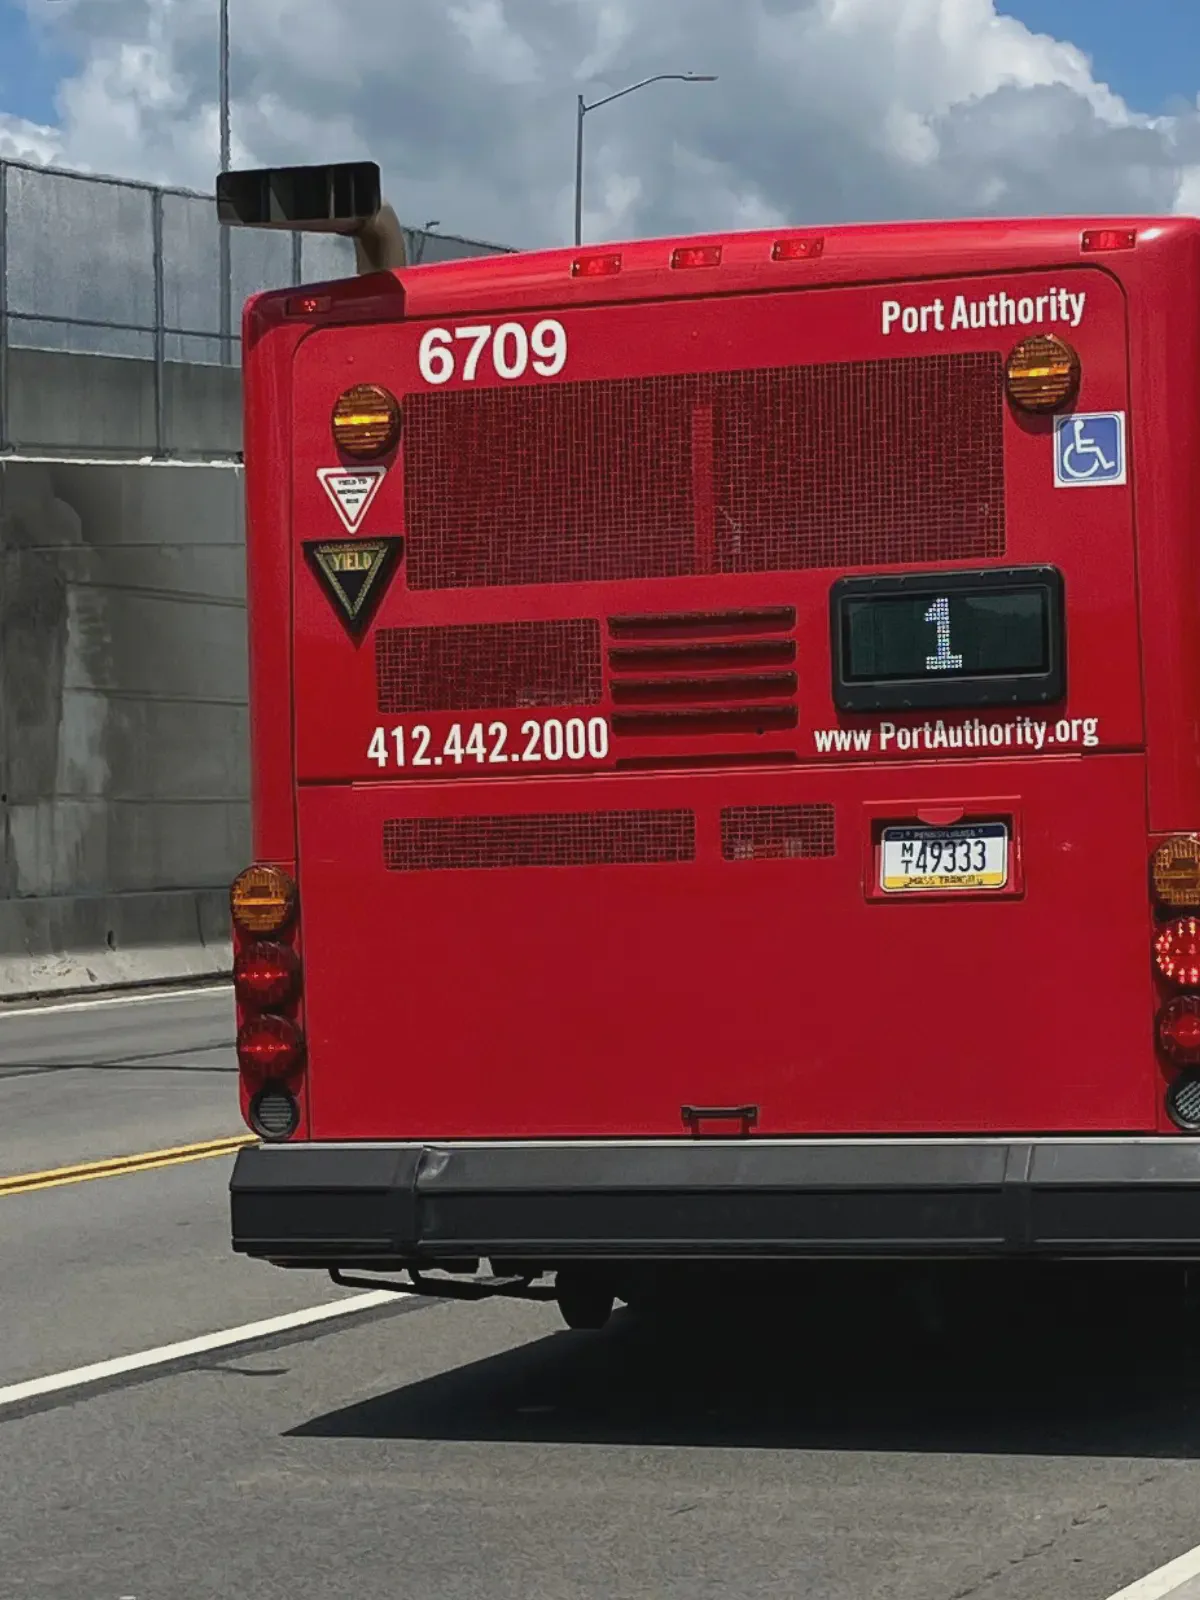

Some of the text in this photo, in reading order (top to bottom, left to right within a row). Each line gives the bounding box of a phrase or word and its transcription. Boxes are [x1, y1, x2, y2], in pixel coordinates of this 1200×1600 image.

[882, 287, 1086, 335] Port Authority
[418, 319, 567, 384] 6709
[331, 551, 372, 571] YIELD
[924, 598, 963, 669] 1
[367, 717, 609, 767] 412.442.2000
[880, 716, 1099, 751] PortAuthority.org
[915, 839, 986, 874] 49333
